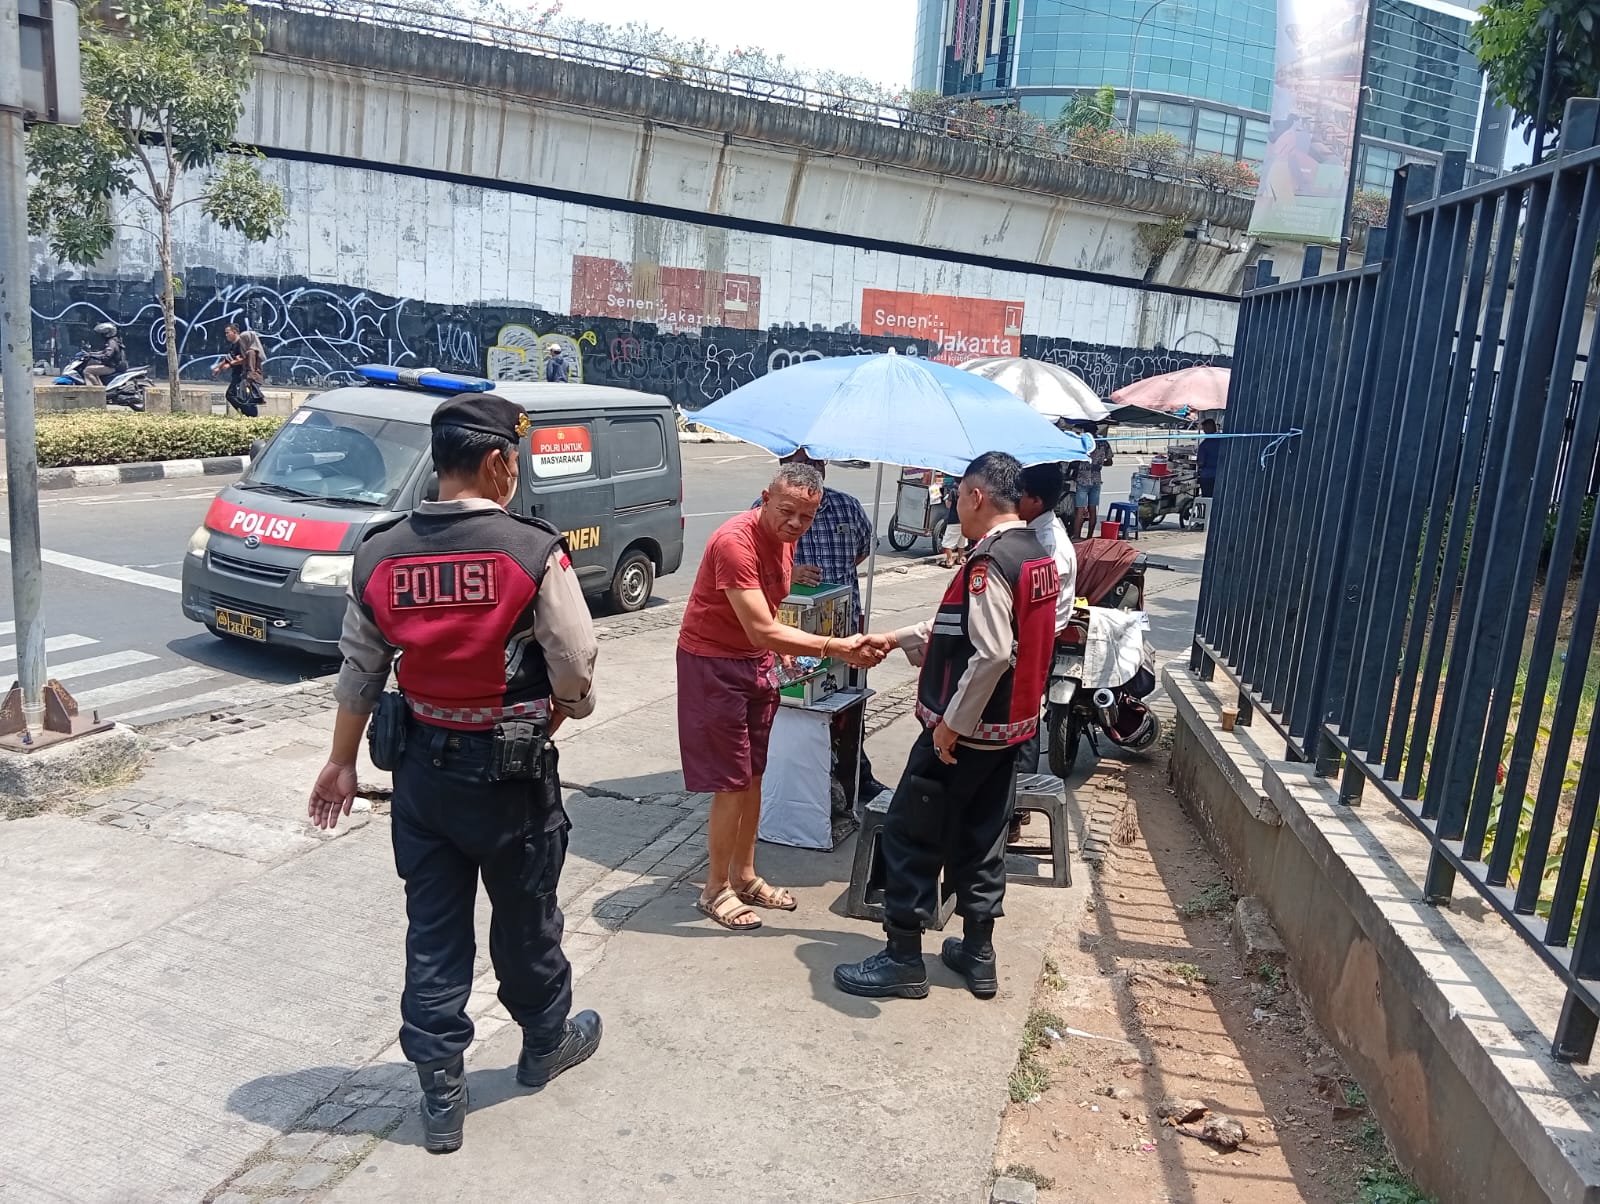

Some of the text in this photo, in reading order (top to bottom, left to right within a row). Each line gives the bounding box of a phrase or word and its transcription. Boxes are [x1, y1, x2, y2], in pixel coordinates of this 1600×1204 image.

[607, 295, 654, 310] Senen
[659, 308, 722, 326] Jakarta
[875, 309, 928, 331] Senen
[936, 328, 1012, 355] Jakarta
[540, 441, 584, 453] POLRI UNTUK
[540, 454, 584, 465] MASYARAKAT
[229, 510, 297, 542] POLISI
[392, 562, 496, 606] POLISI
[1031, 561, 1059, 600] POLIS
